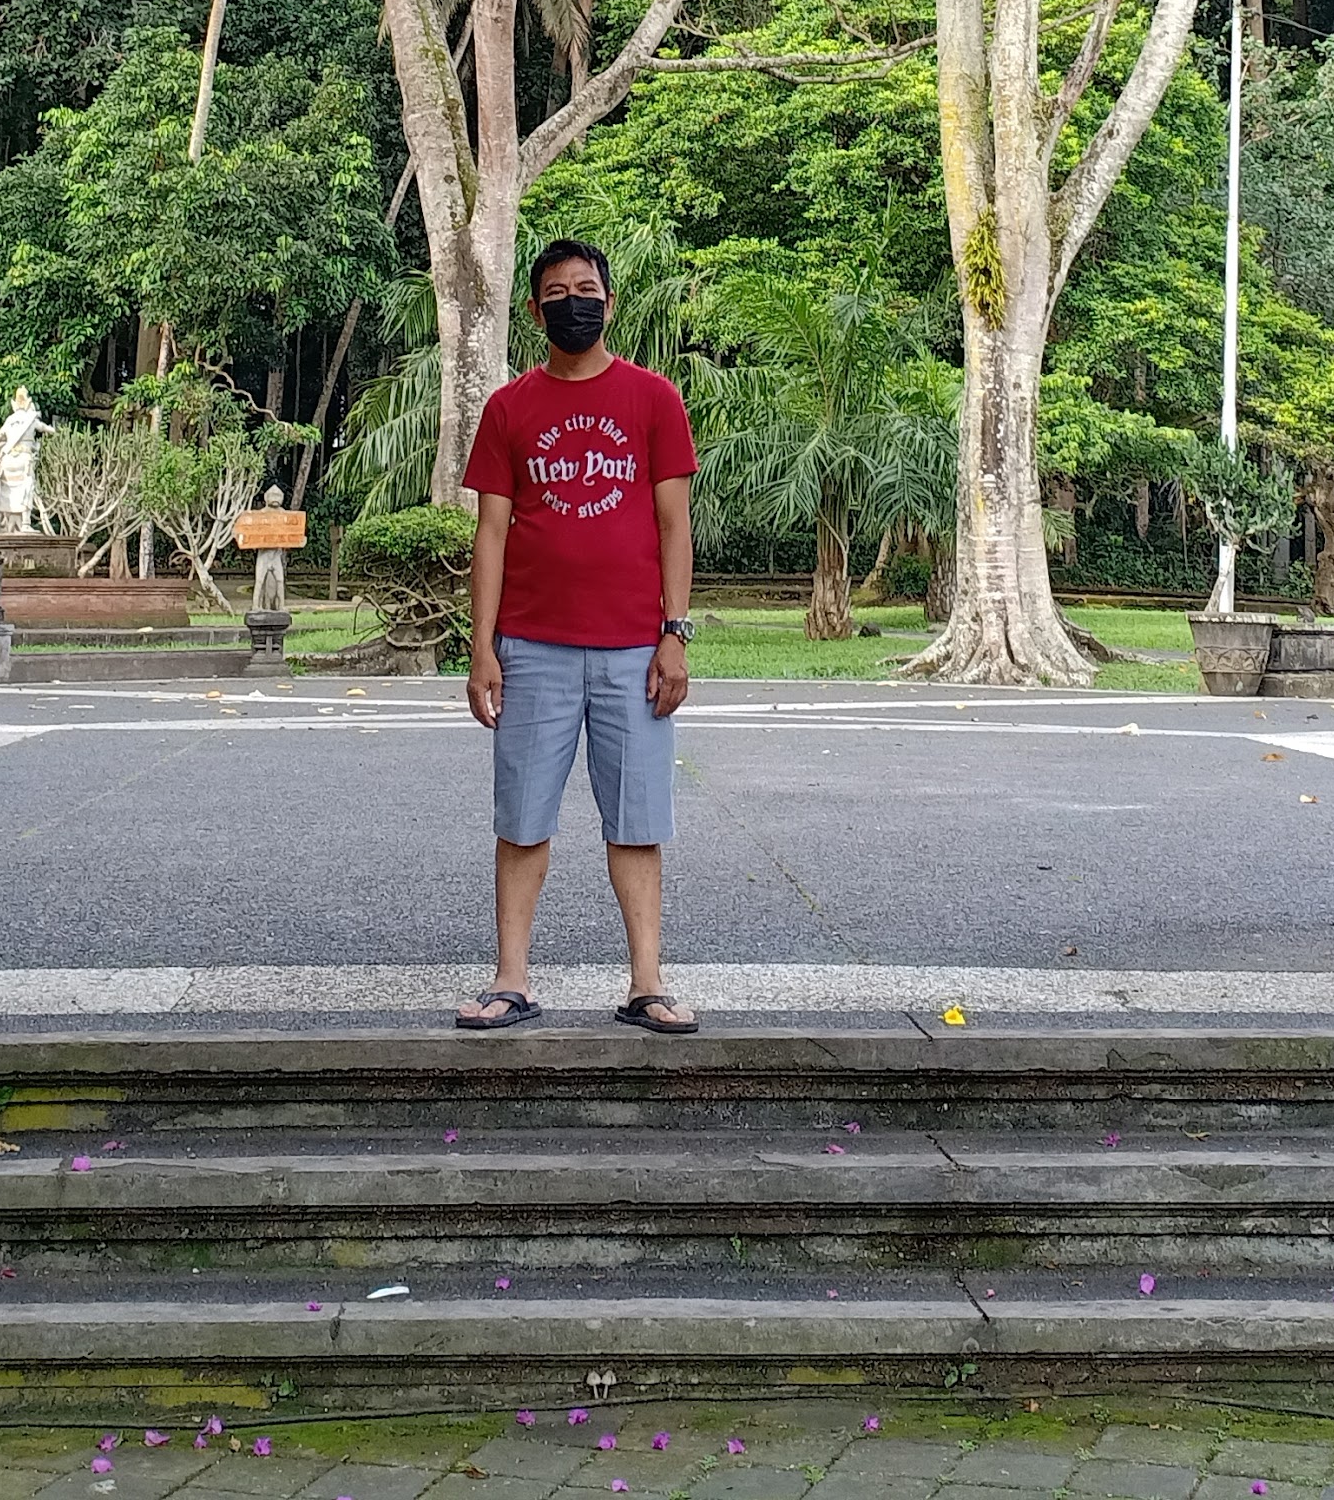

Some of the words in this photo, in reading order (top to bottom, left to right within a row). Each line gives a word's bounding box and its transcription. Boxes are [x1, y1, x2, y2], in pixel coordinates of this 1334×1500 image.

[536, 426, 561, 450] the
[564, 414, 595, 432] city
[598, 415, 628, 446] that
[525, 456, 579, 484] New
[581, 451, 636, 486] York
[577, 485, 623, 518] sleeps
